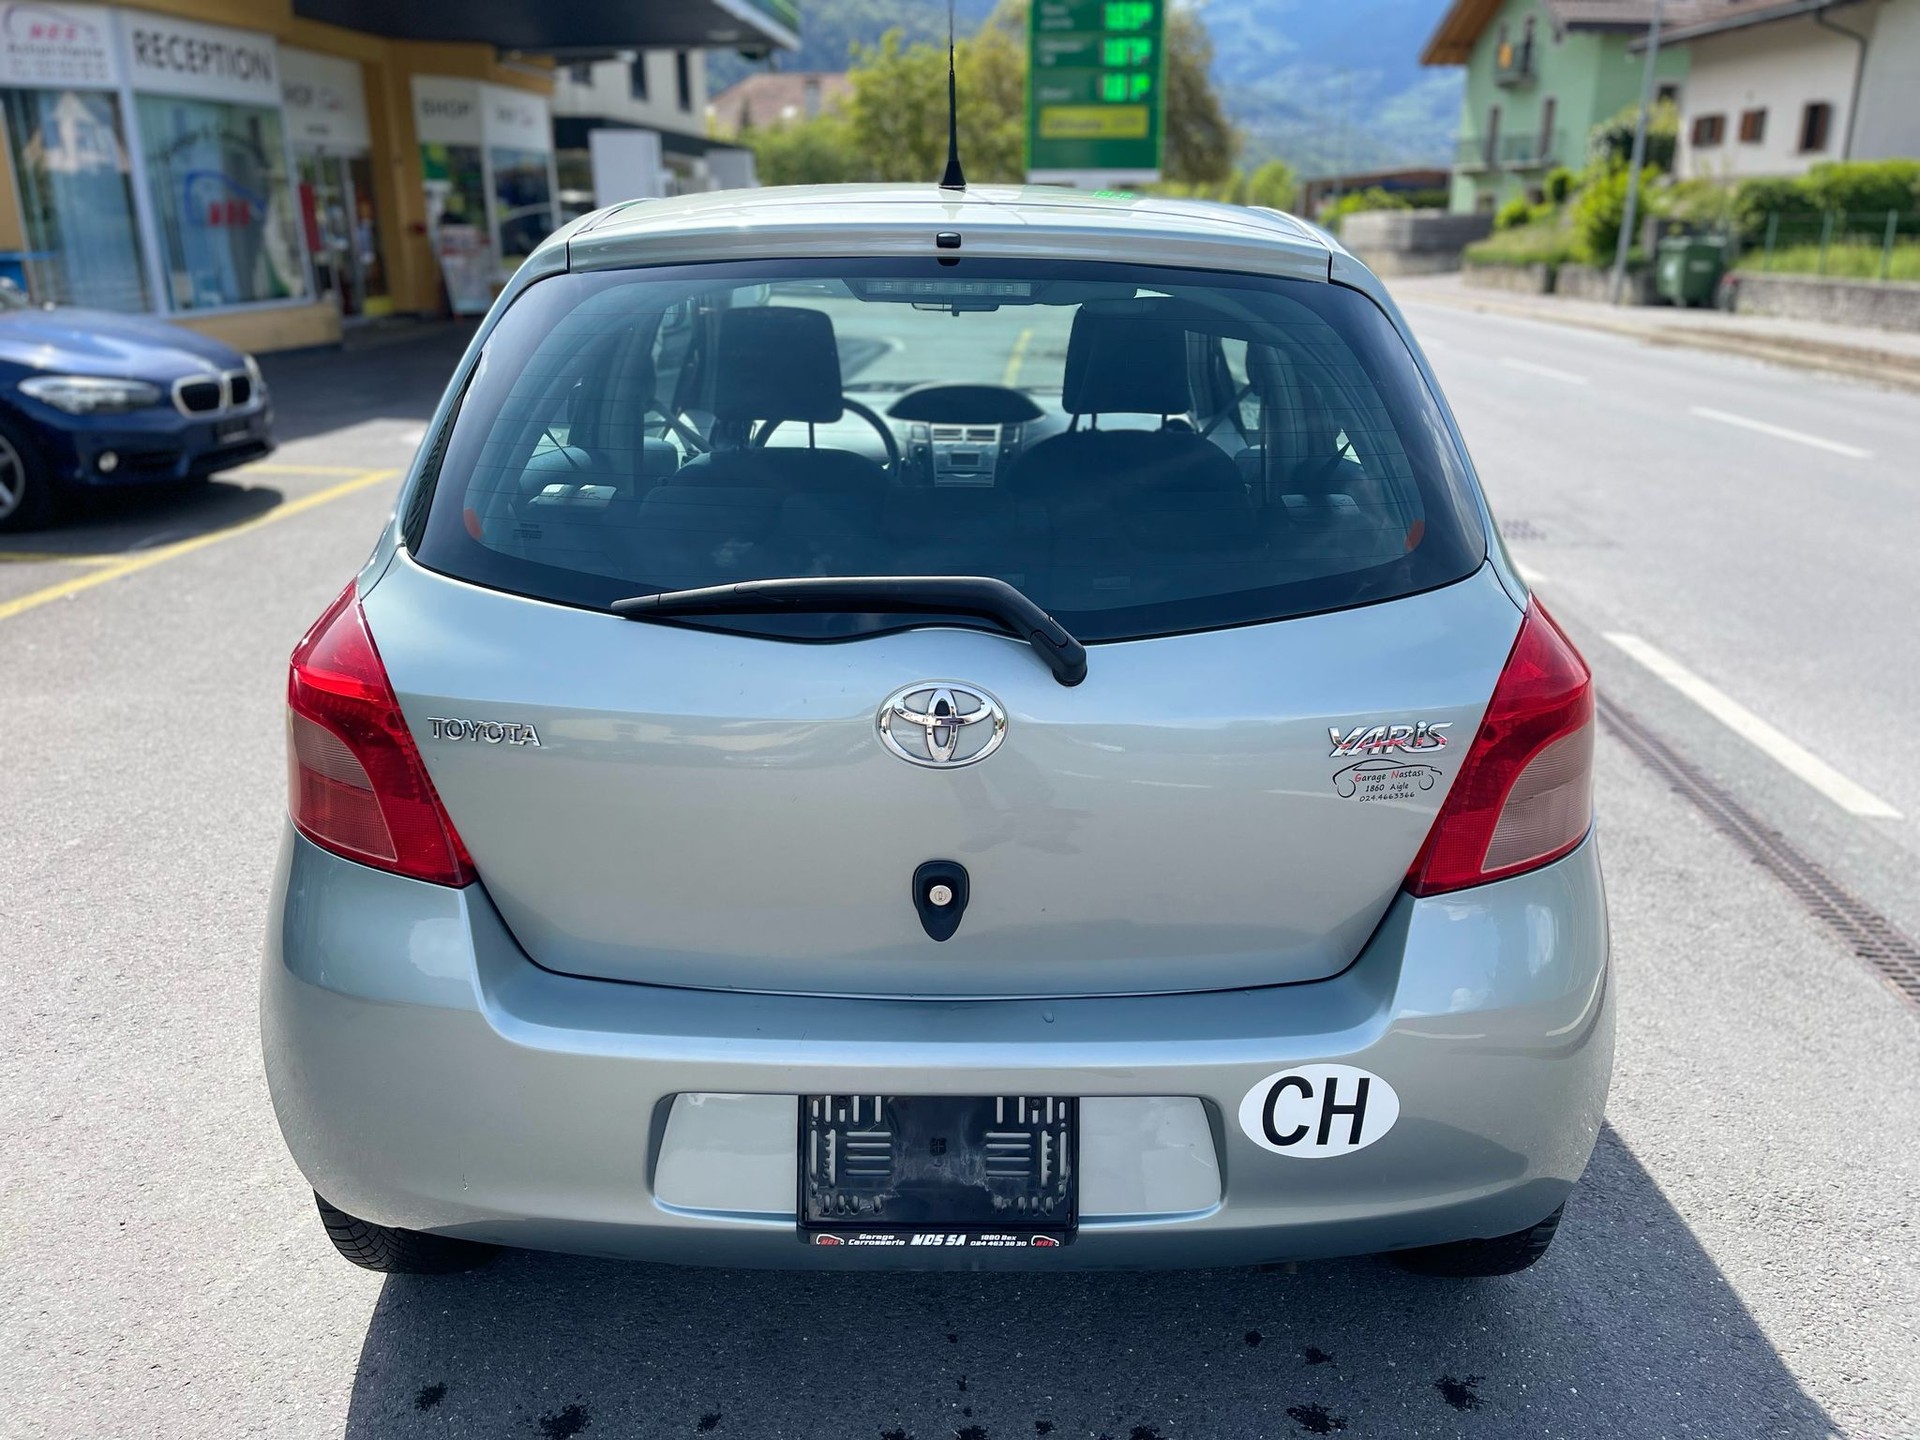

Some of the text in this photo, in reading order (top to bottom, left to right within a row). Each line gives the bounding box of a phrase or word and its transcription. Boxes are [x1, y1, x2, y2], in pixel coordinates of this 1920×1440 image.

[133, 30, 272, 82] RECEPTION
[427, 717, 541, 746] TOYOTA
[1355, 770, 1424, 783] Garage Nastasi
[1366, 782, 1409, 792] 1860 Aigle
[1262, 1075, 1371, 1146] CH
[858, 1233, 895, 1241] Garage
[910, 1234, 967, 1246] MDS SA
